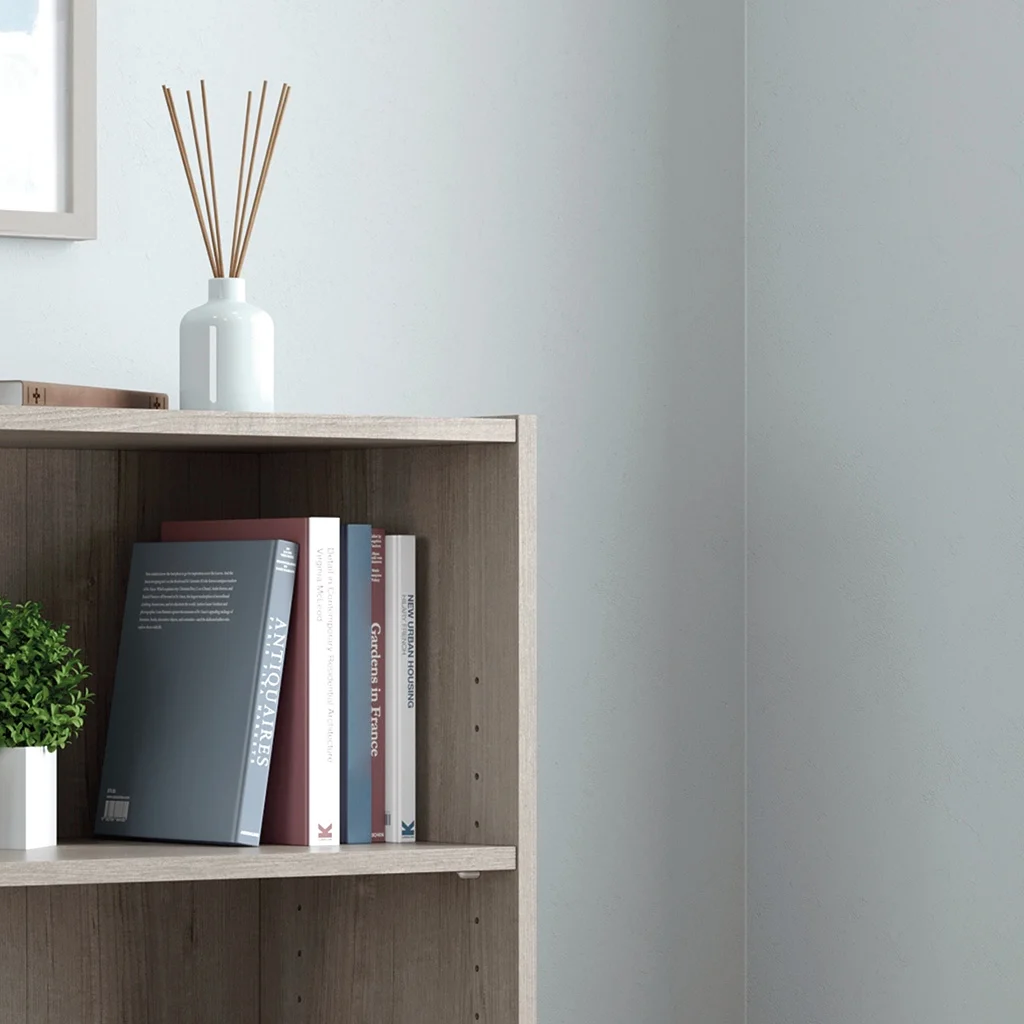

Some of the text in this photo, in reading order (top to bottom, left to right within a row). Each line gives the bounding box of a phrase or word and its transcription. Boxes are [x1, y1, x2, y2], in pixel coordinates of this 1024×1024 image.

[256, 617, 287, 767] ANTIQUAIRES
[371, 622, 382, 757] Gardens in France
